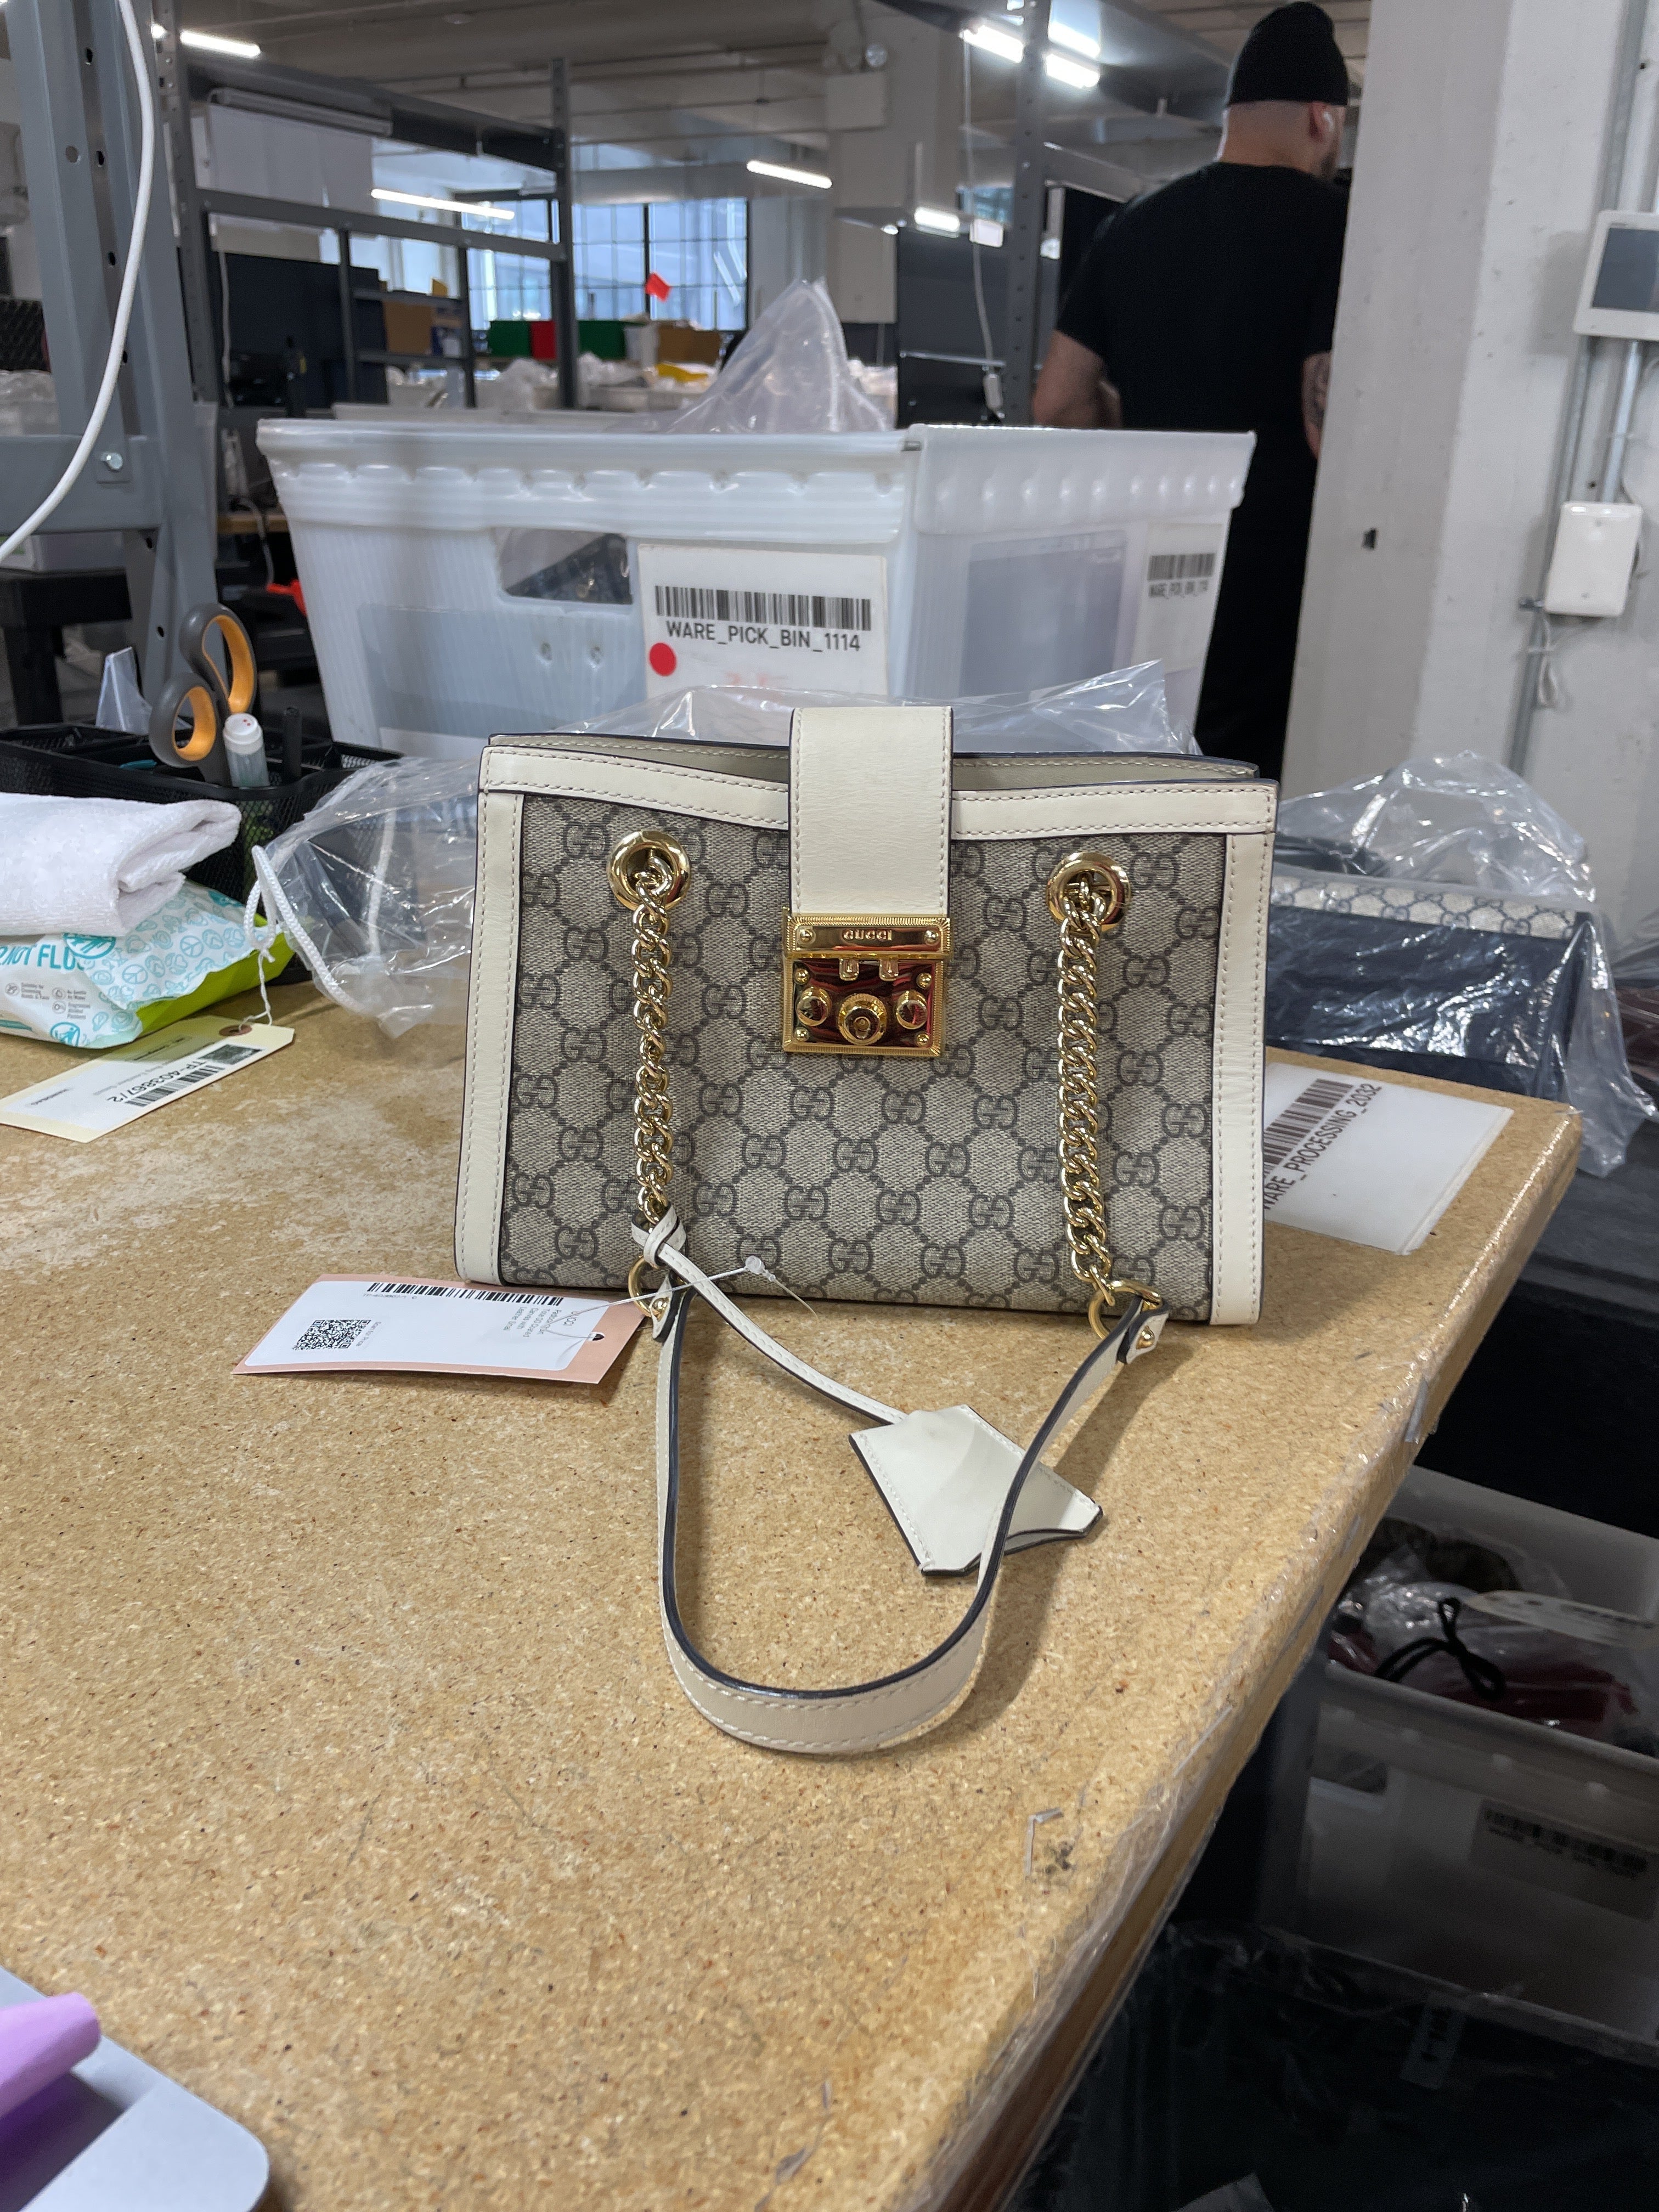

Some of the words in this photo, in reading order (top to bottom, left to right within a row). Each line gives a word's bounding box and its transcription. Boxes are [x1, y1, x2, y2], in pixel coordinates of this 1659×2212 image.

[665, 620, 861, 652] WARE_PICK_BIN_1114
[843, 929, 893, 941] GUCCI
[37, 944, 84, 971] FLU
